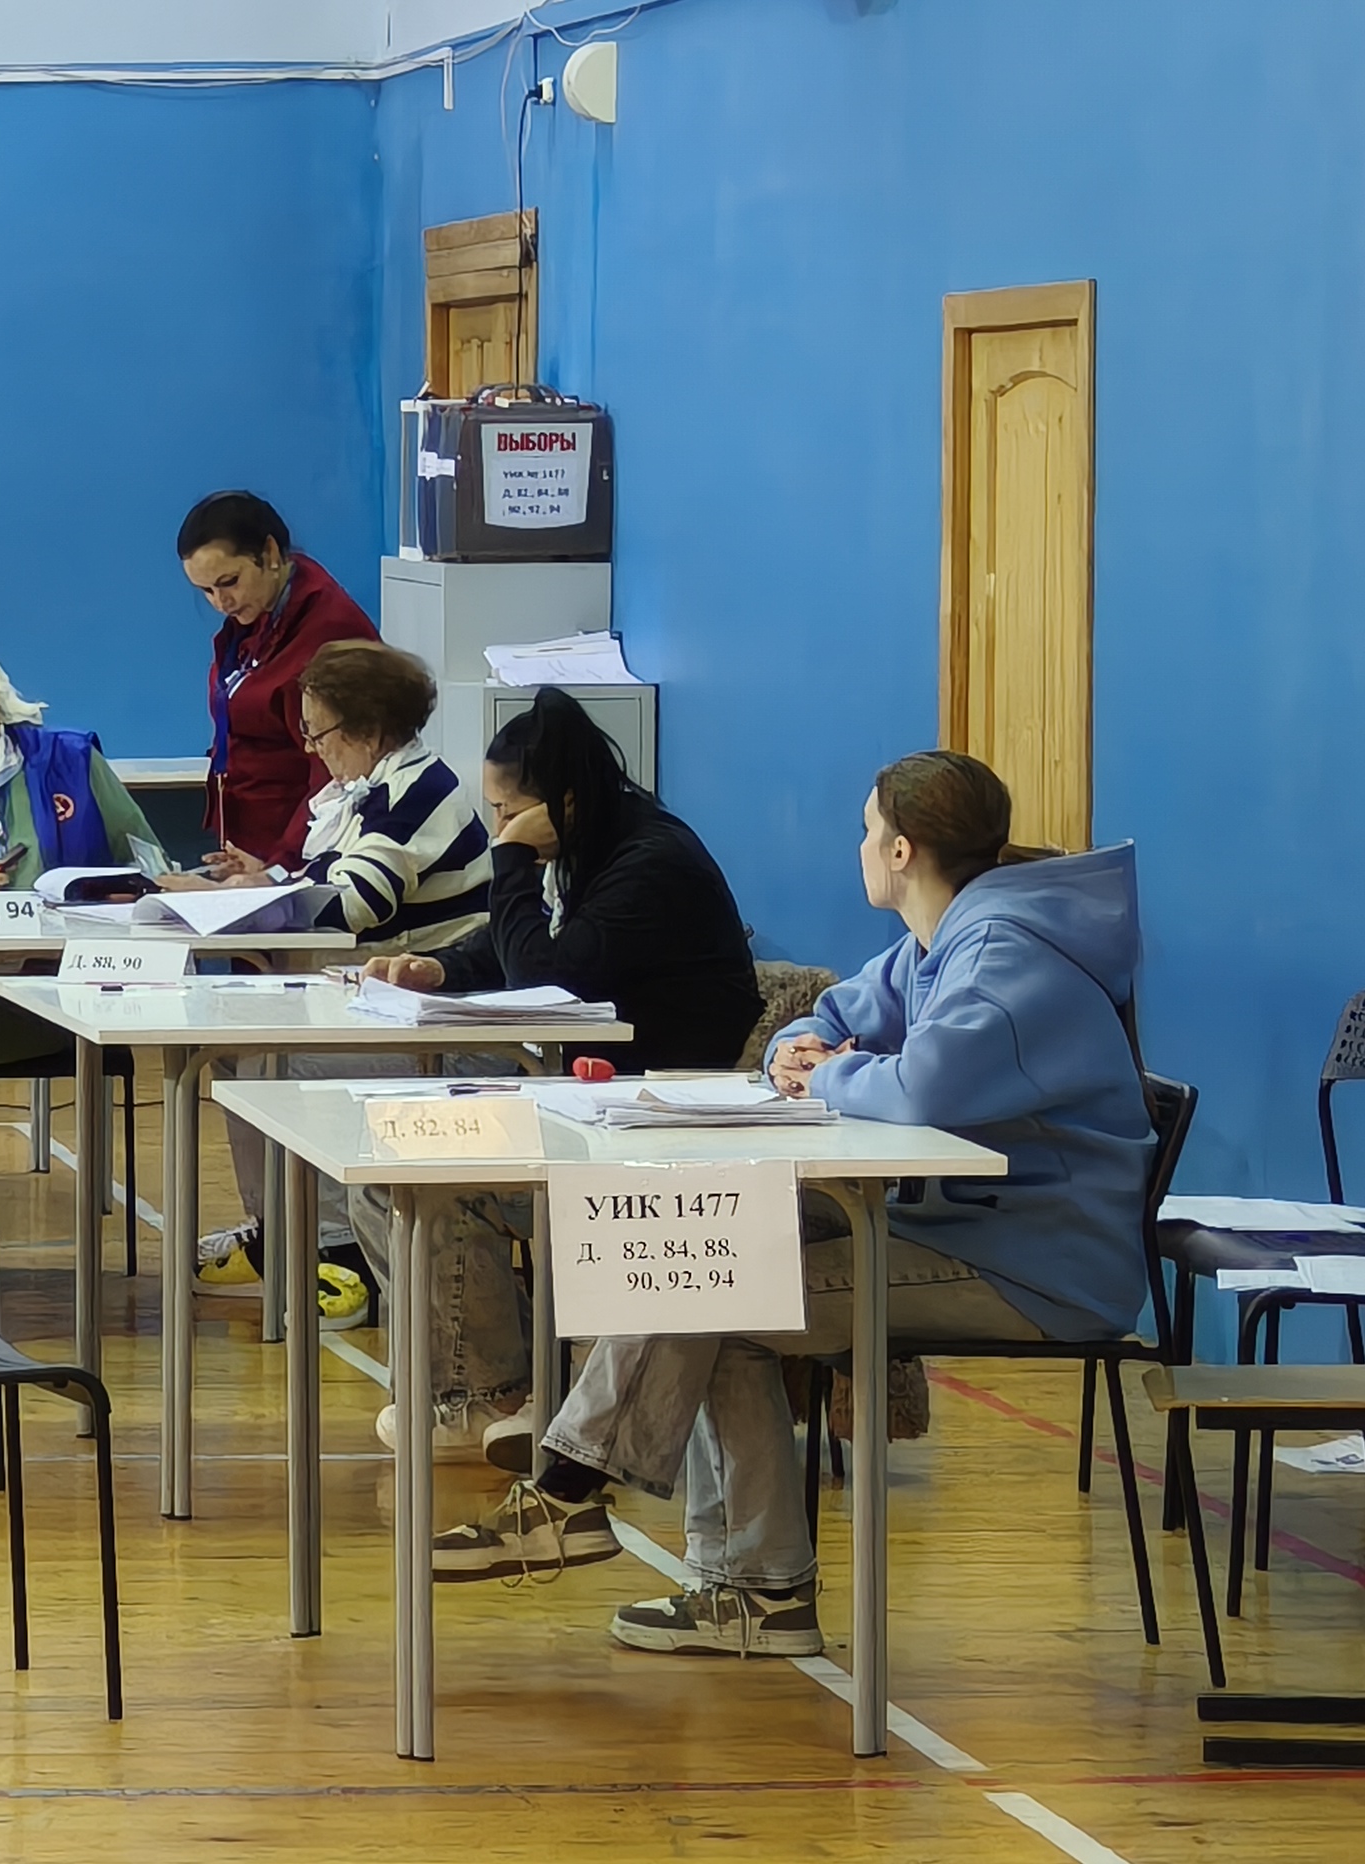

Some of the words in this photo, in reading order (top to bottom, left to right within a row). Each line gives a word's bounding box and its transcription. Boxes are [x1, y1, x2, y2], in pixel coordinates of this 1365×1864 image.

[497, 432, 576, 451] ВЫБОРЫ
[6, 901, 35, 918] 94
[121, 957, 142, 970] 90
[381, 1119, 406, 1143] Д.
[454, 1118, 480, 1136] 84
[584, 1194, 662, 1220] УИК
[675, 1193, 740, 1218] 1477
[576, 1243, 601, 1265] Д.
[663, 1240, 697, 1260] 84,
[704, 1238, 738, 1258] 88,
[668, 1270, 701, 1291] 92,
[708, 1269, 735, 1288] 94
